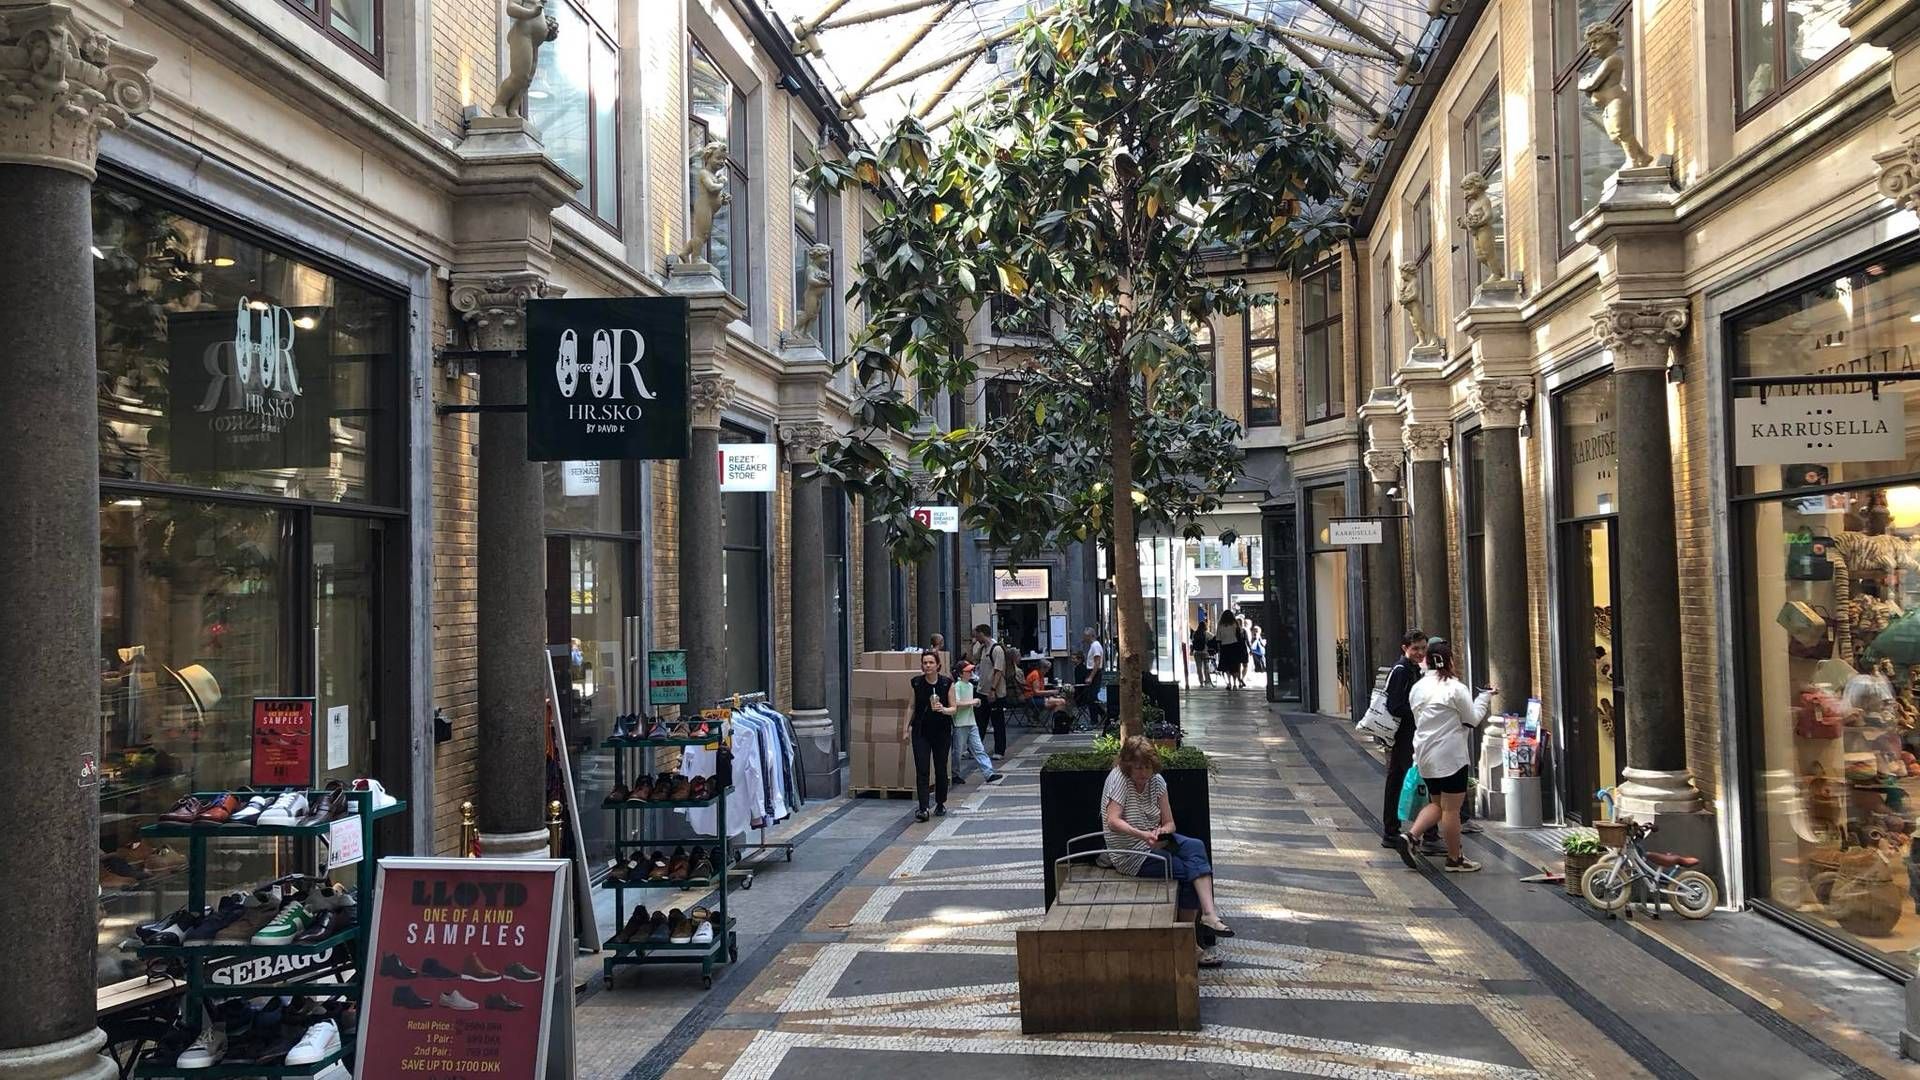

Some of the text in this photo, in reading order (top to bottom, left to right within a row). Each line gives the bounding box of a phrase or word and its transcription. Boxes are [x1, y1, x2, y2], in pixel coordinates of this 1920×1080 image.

[569, 404, 642, 421] HR.SKO
[586, 423, 625, 433] BY DAVID K
[1751, 419, 1889, 438] KARRUSELLA
[1571, 431, 1617, 465] KARRUSE
[728, 455, 755, 463] REZET
[263, 716, 304, 725] SAMPLES
[411, 879, 529, 908] LLOYD
[423, 908, 514, 924] ONE OF A KIND
[407, 922, 526, 946] SAMPLES
[407, 1020, 430, 1030] Retail
[427, 1034, 431, 1043] 1
[414, 1046, 430, 1056] 2nd
[401, 1059, 501, 1072] SAVE UP TO 1700 DKK
